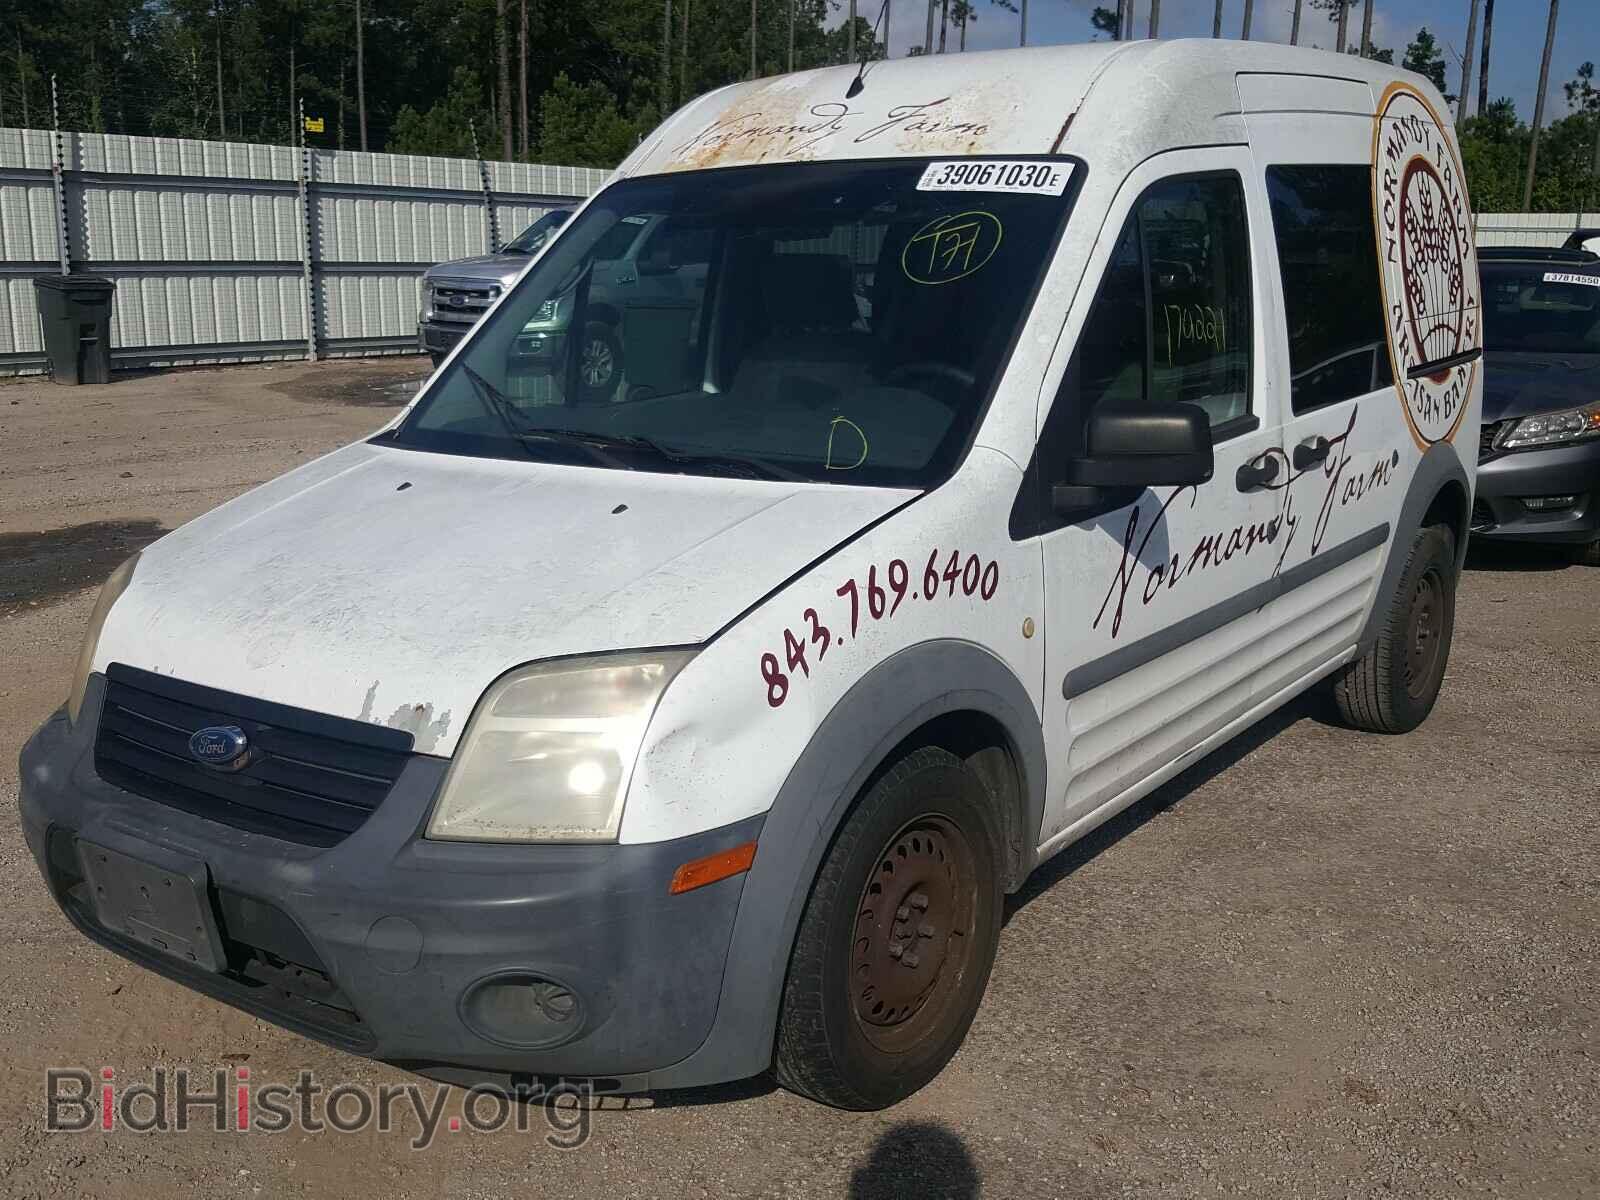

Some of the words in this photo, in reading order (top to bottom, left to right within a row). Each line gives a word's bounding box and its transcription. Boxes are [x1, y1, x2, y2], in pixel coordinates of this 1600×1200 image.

[824, 415, 868, 470] D
[760, 547, 999, 708] 843.769.6400
[198, 735, 226, 754] Ford
